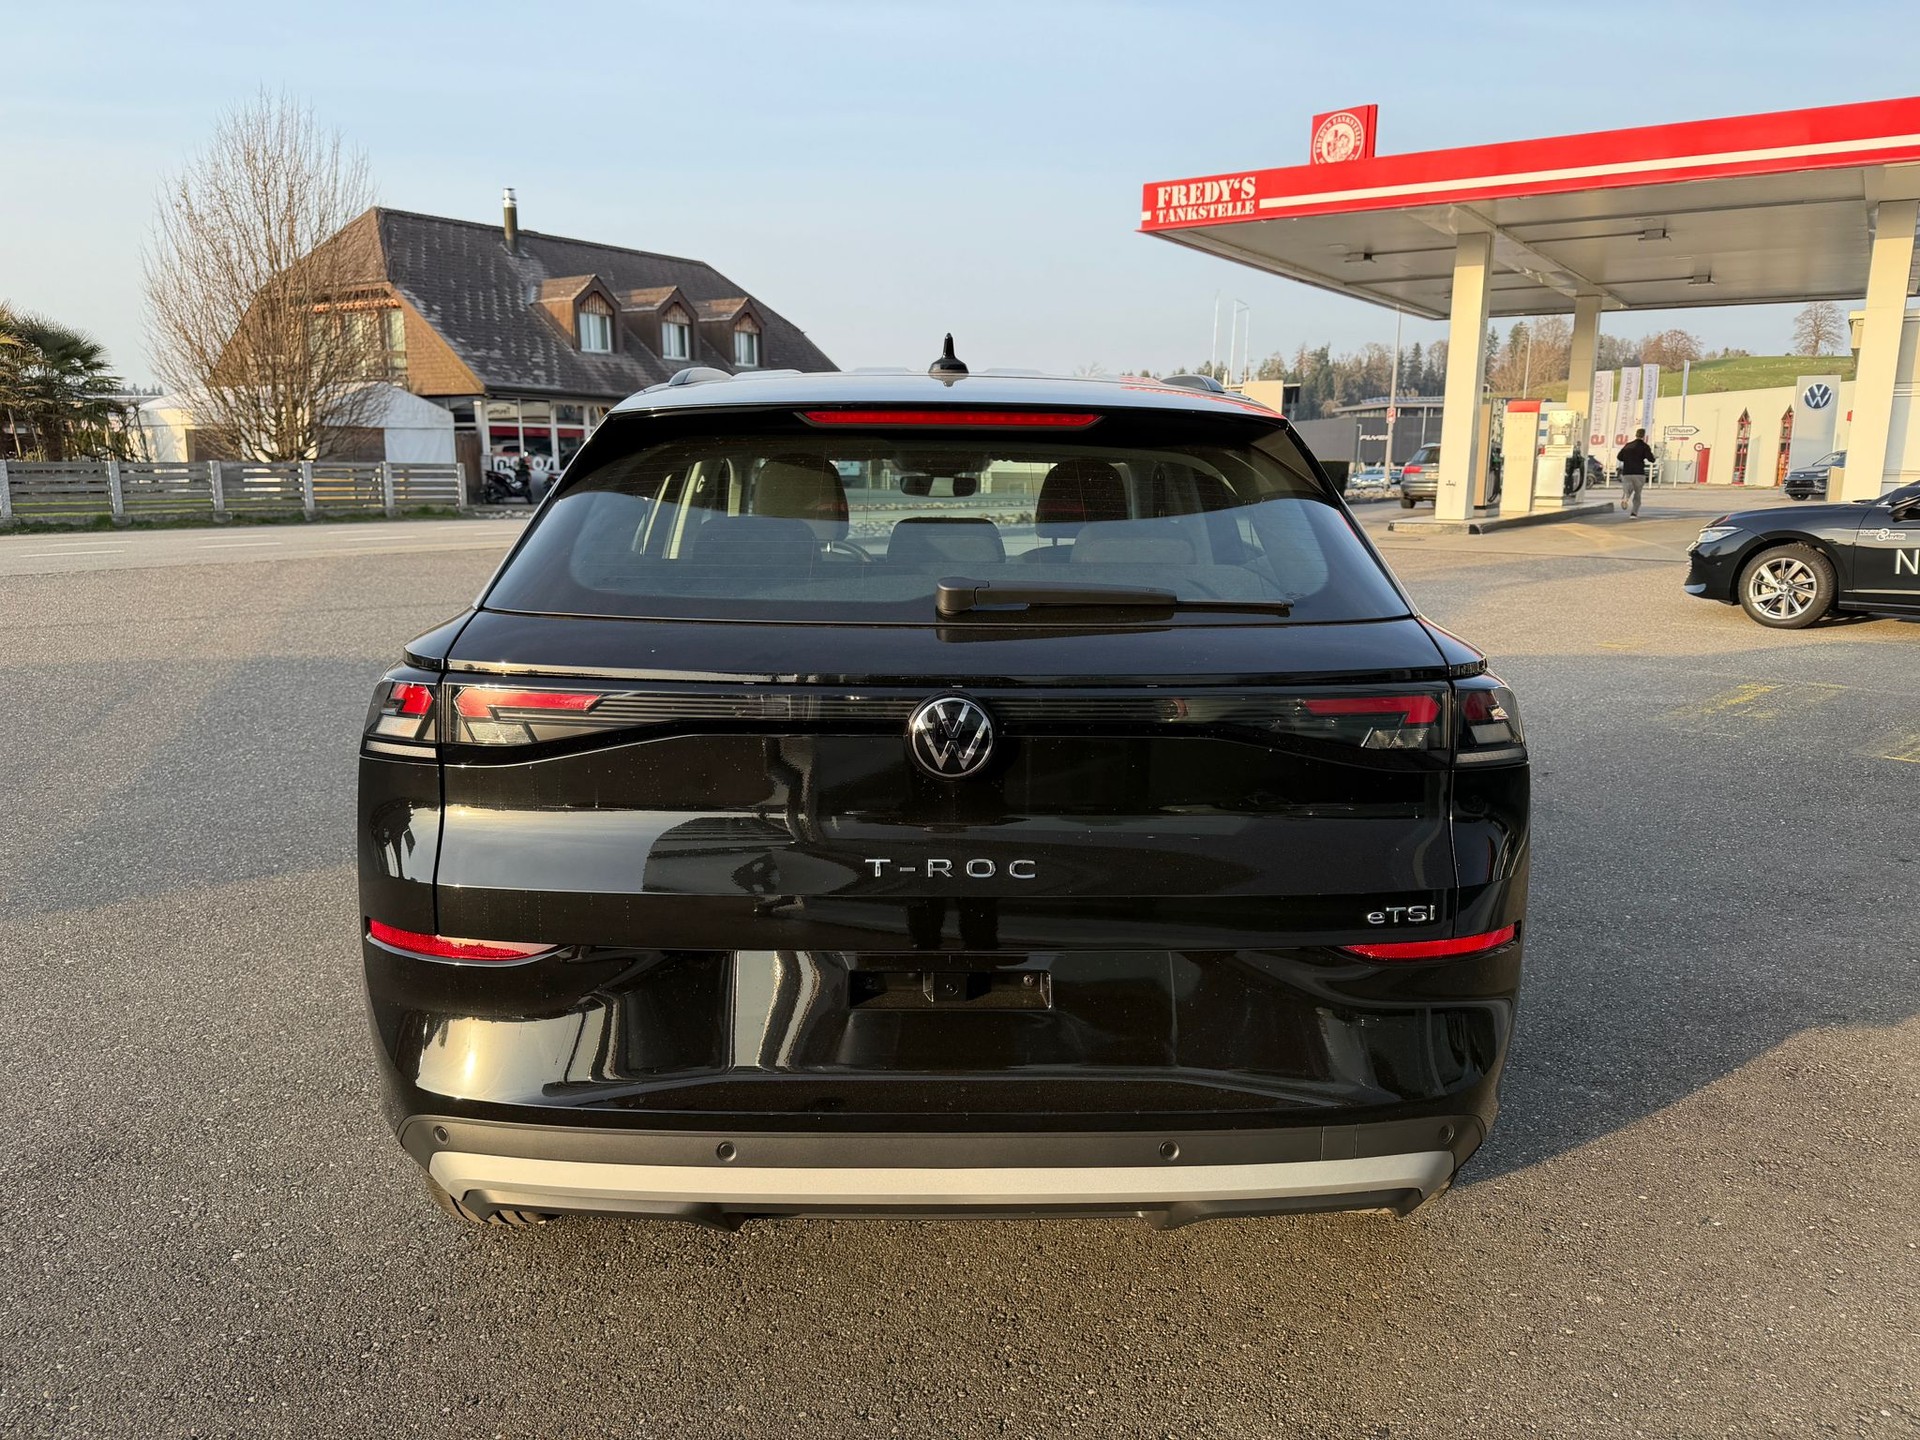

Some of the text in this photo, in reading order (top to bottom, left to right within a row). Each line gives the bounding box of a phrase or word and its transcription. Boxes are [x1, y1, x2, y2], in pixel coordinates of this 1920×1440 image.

[1156, 176, 1256, 208] FREDY'S
[1156, 200, 1255, 224] TANKSTELLE
[864, 858, 1037, 879] T-ROC
[1366, 904, 1435, 925] eTSI
